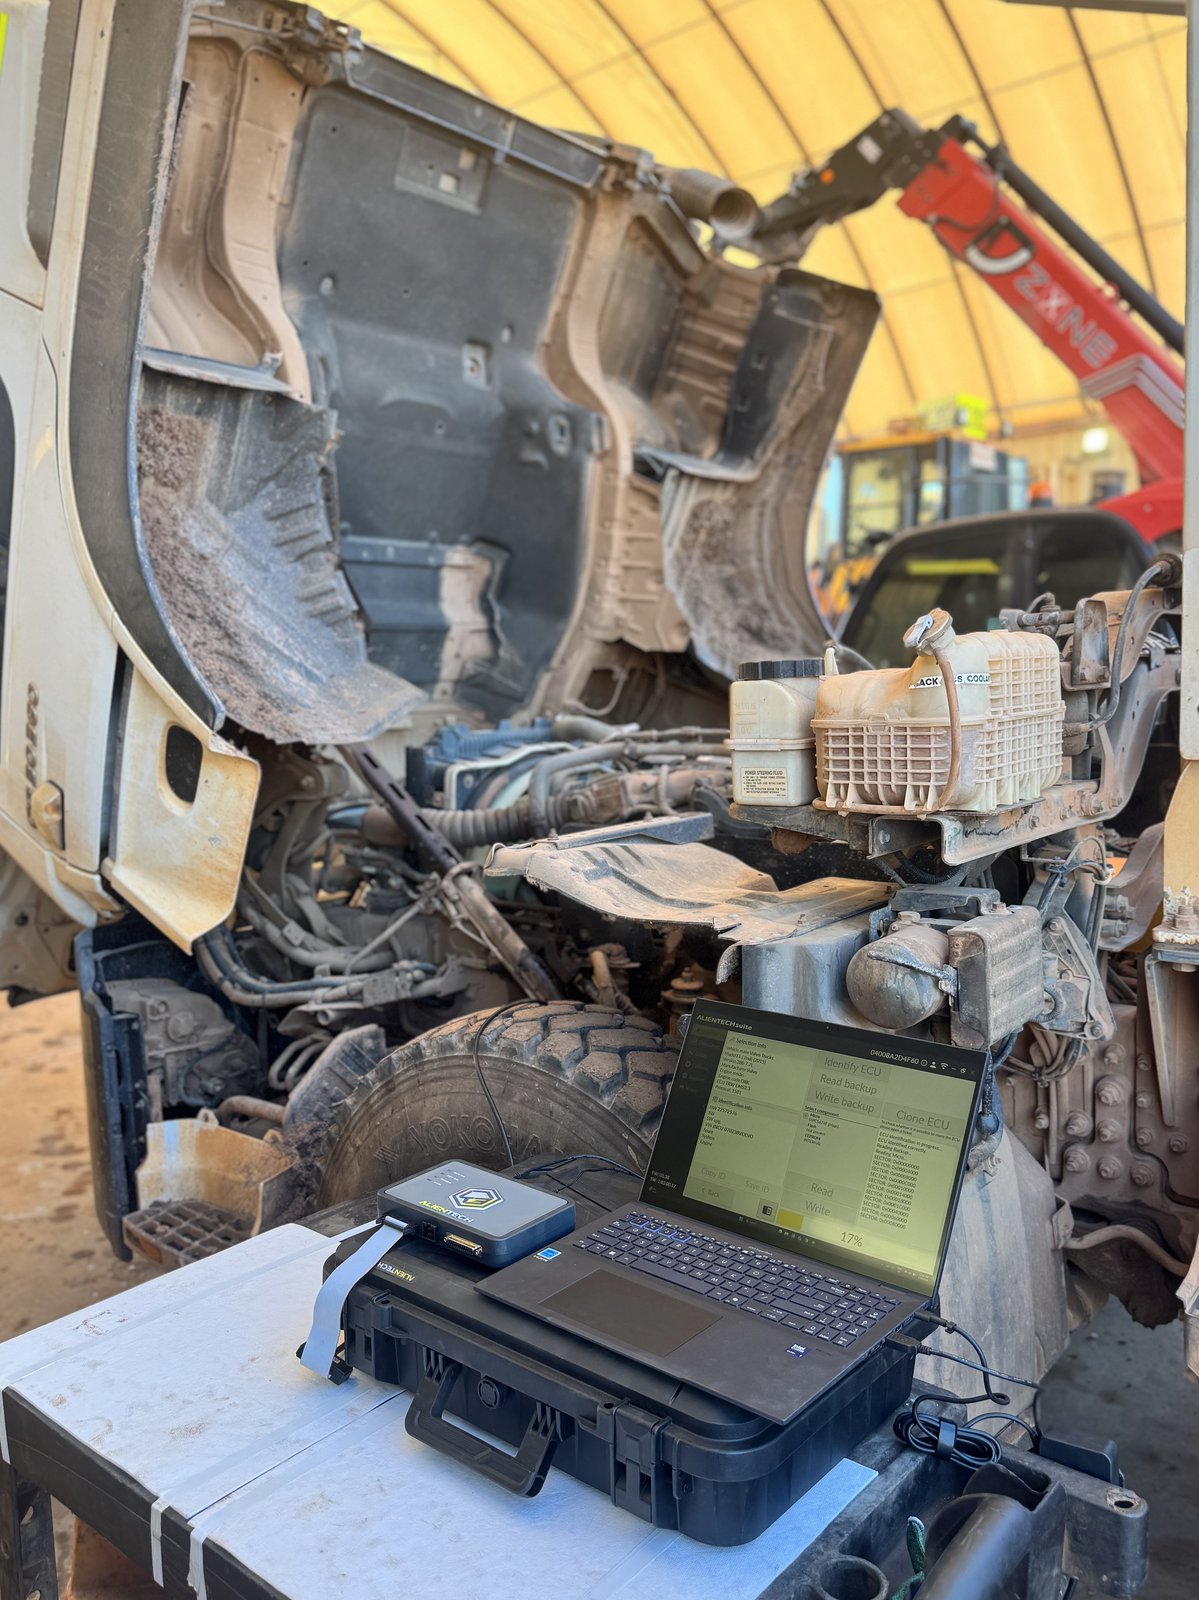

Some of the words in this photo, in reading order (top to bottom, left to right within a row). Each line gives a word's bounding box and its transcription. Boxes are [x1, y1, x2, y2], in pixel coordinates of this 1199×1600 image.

[825, 1057, 858, 1072] Identify
[861, 1065, 881, 1076] ECU
[820, 1074, 842, 1086] Read
[844, 1079, 877, 1095] backup
[815, 1091, 839, 1104] Write
[841, 1097, 875, 1114] backup
[896, 1110, 924, 1124] Clone
[927, 1117, 949, 1130] ECU
[811, 1183, 833, 1197] Read
[418, 1200, 474, 1224] ALIENTECH
[805, 1201, 830, 1215] Write
[840, 1232, 863, 1248] 17%
[377, 1261, 415, 1282] ALIENTECH
